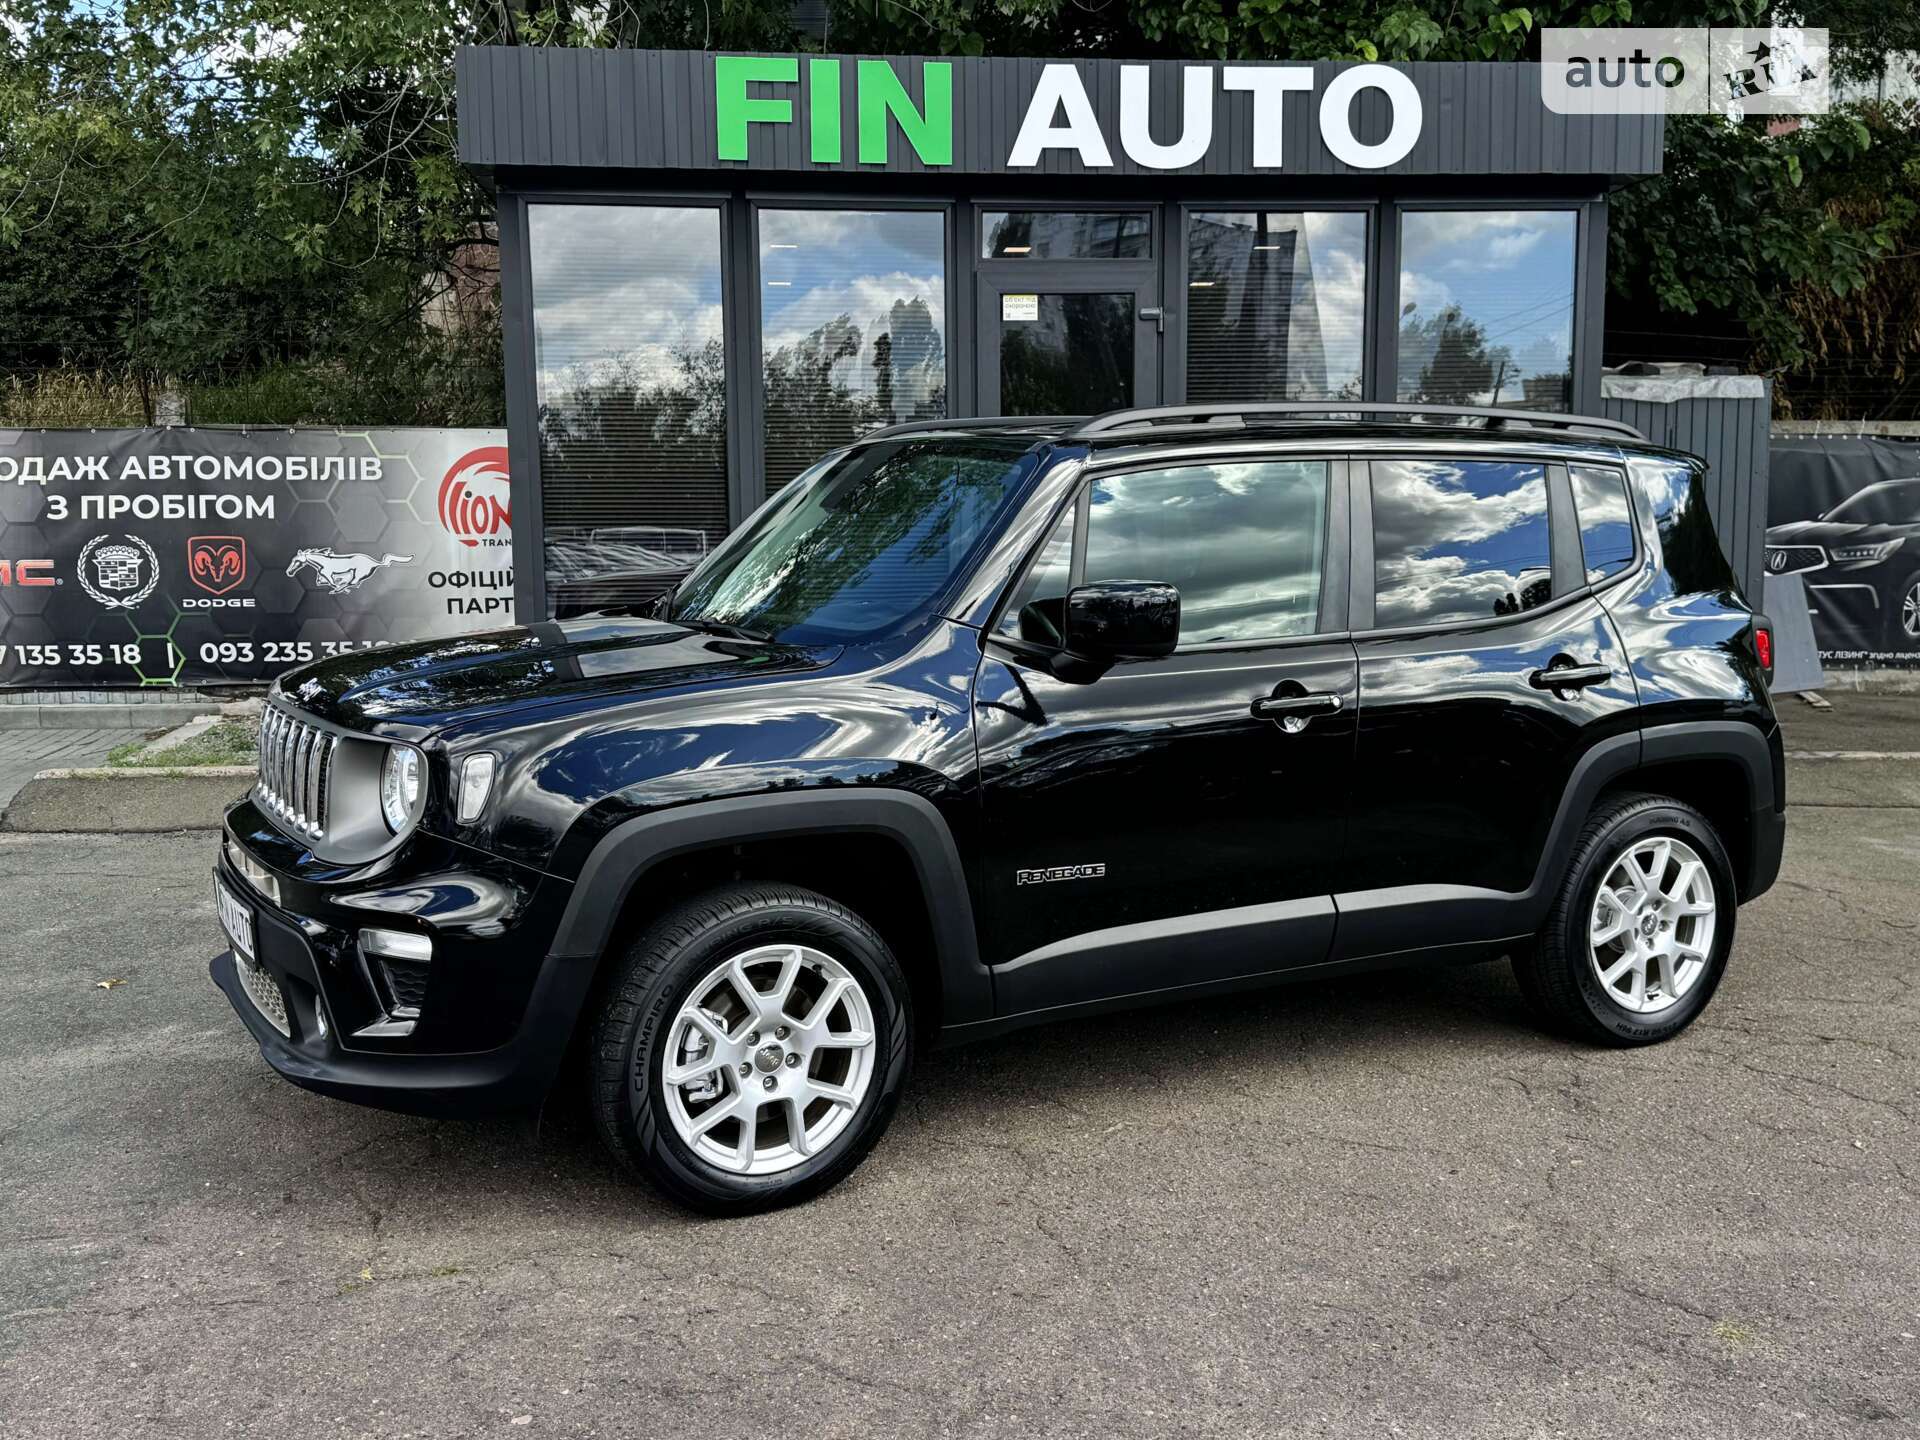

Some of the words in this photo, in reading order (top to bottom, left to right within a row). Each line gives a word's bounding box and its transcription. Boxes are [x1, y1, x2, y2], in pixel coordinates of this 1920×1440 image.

[715, 55, 953, 165] FIN
[1006, 63, 1423, 170] AUTO
[0, 455, 110, 486] ОДАЖ
[119, 455, 383, 481] АВТОМОБІЛІВ
[80, 494, 276, 520] ПРОБІГОМ
[182, 598, 256, 608] DODGE
[447, 597, 514, 615] ПАРТ
[14, 644, 62, 666] 135
[68, 644, 104, 665] 35
[109, 644, 142, 665] 18
[200, 642, 255, 663] 093
[261, 641, 314, 662] 235
[1017, 863, 1106, 886] RENEGADE
[634, 984, 674, 1092] CHAMPIRO
